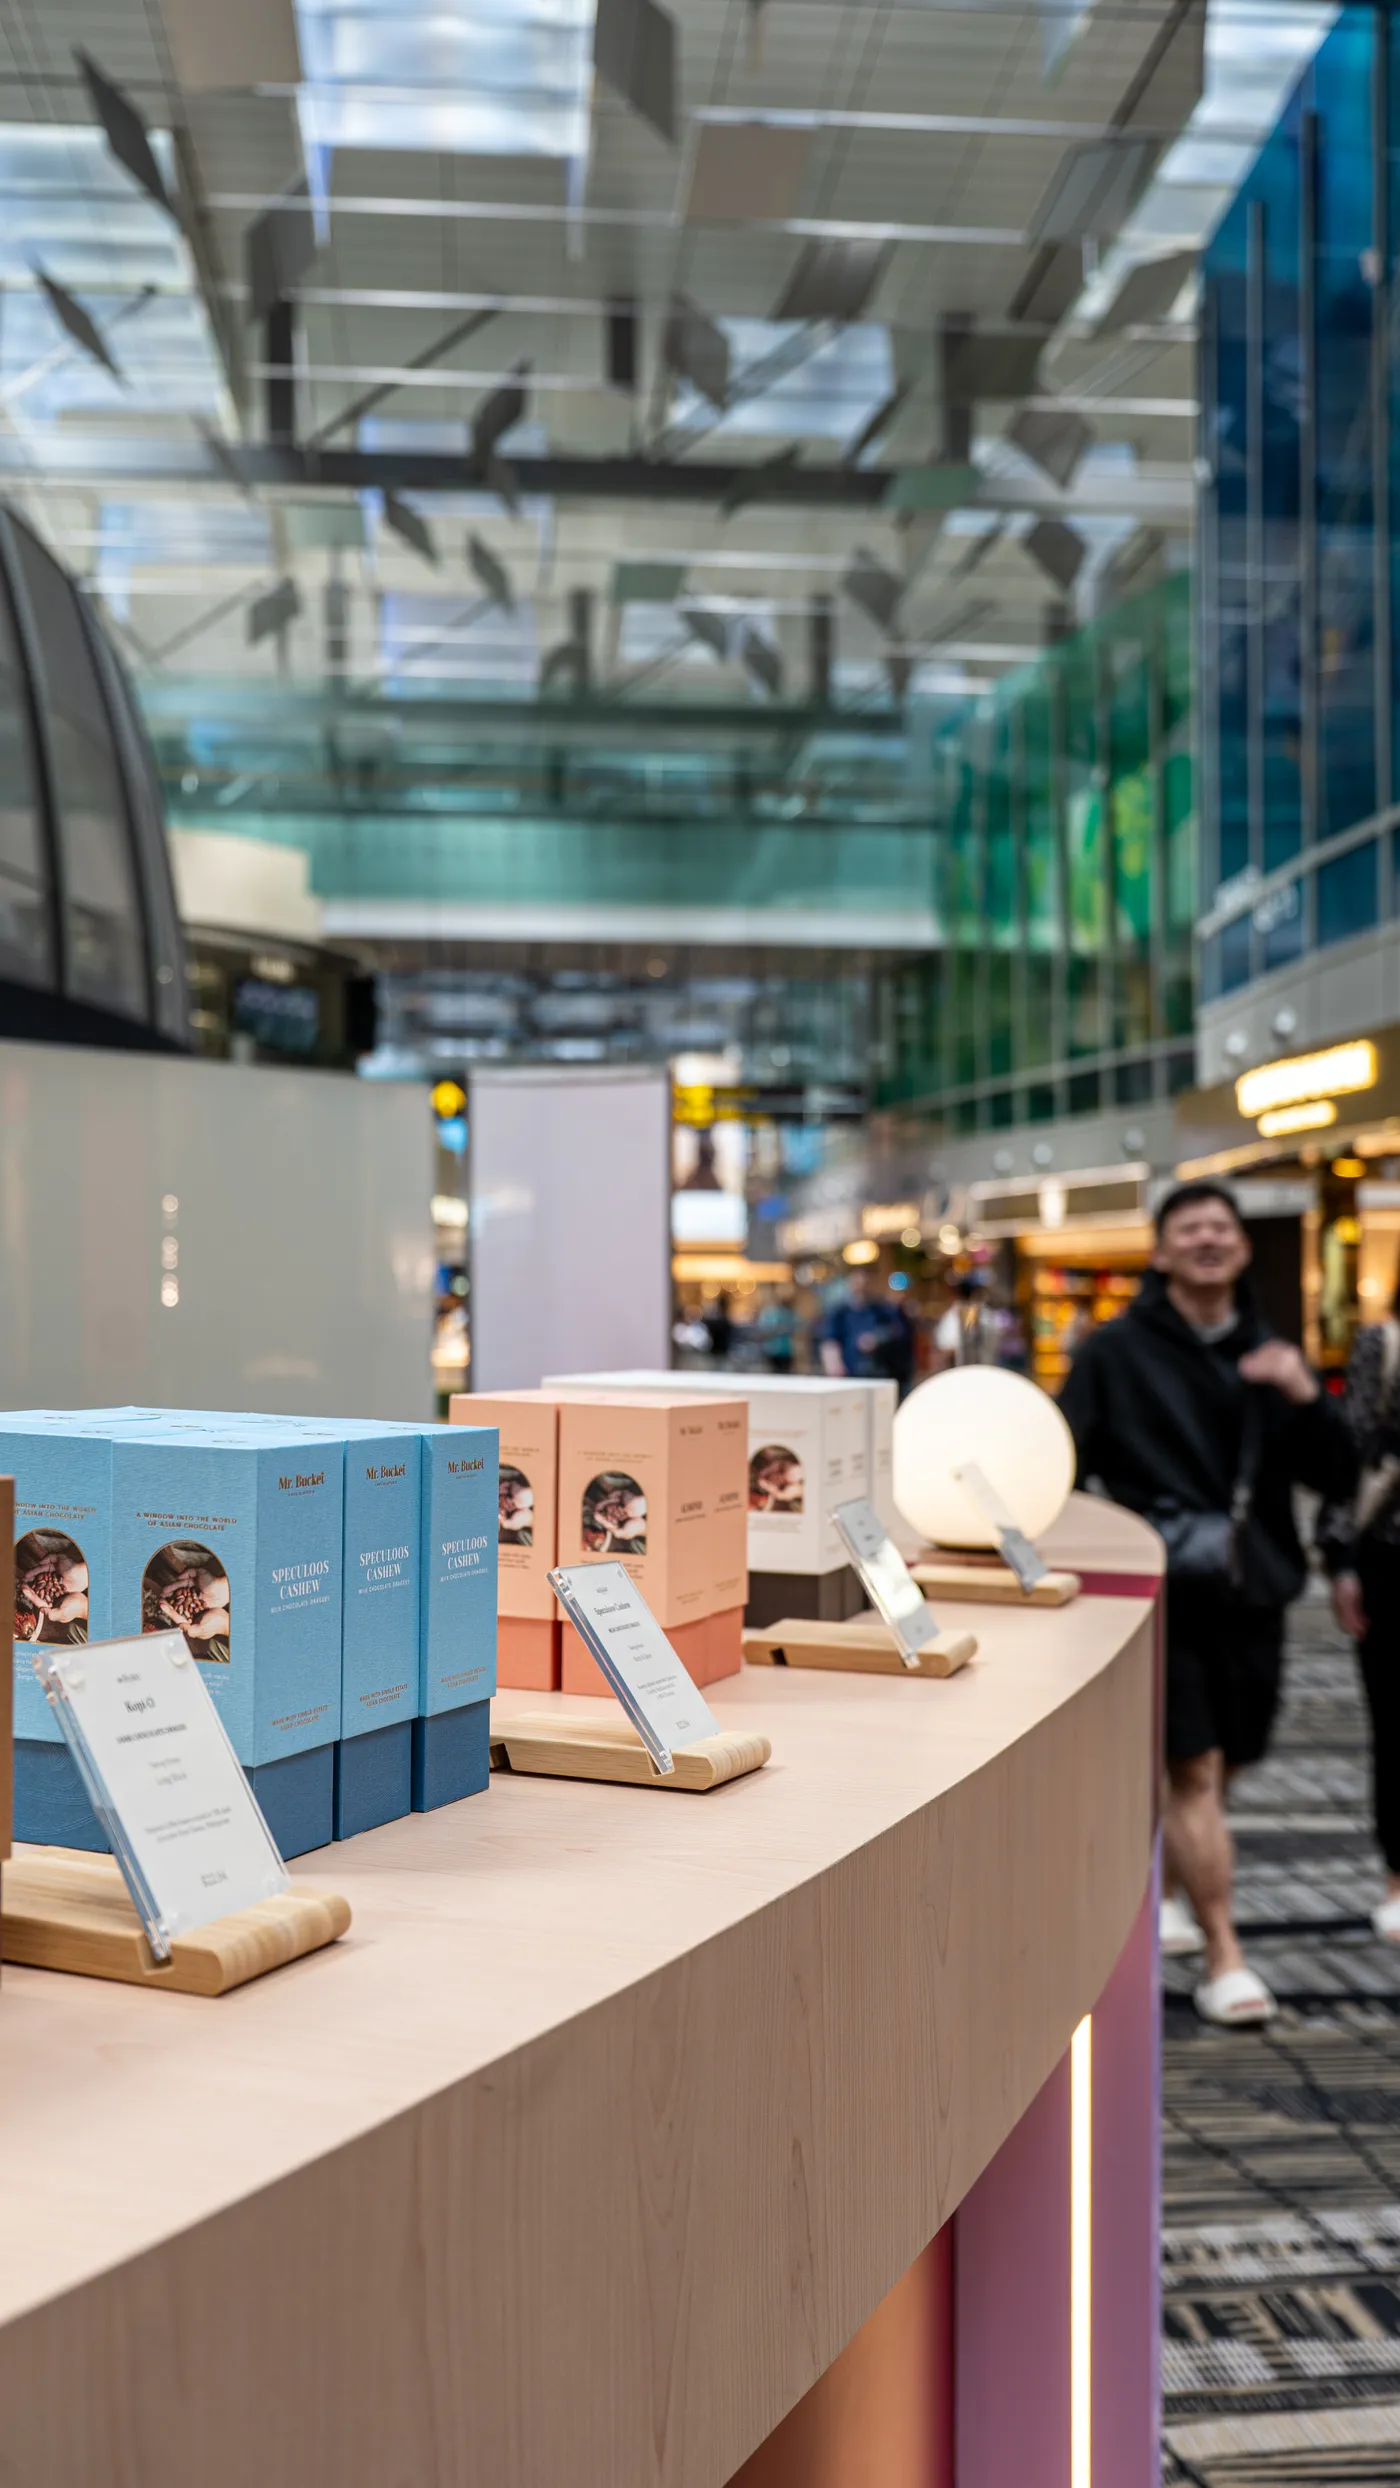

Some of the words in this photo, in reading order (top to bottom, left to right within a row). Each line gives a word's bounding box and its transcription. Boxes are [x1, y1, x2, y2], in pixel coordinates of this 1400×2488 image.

[366, 1466, 379, 1480] Mr.
[380, 1463, 406, 1478] Bucket
[447, 1461, 459, 1473] Mr.
[461, 1457, 484, 1472] Bucket
[279, 1476, 293, 1490] Mr.
[295, 1471, 325, 1488] Bucket
[45, 1511, 85, 1520] CHOCOLATE
[72, 1505, 96, 1513] WORLD
[143, 1511, 175, 1520] WINDOW
[211, 1517, 237, 1525] WORLD
[159, 1521, 182, 1529] ASIAN
[183, 1523, 225, 1532] CHOCOLATE
[441, 1536, 488, 1556] SPECULOOS
[359, 1545, 409, 1567] SPECULOOS
[447, 1552, 481, 1570] CASHEW
[271, 1560, 329, 1584] SPECULOOS
[366, 1562, 402, 1582] CASHEW
[279, 1579, 321, 1600] CASHEW
[594, 1604, 616, 1617] Speculoos
[378, 1692, 401, 1704] CHOCOLATE
[295, 1715, 319, 1727] CHOCOLATE
